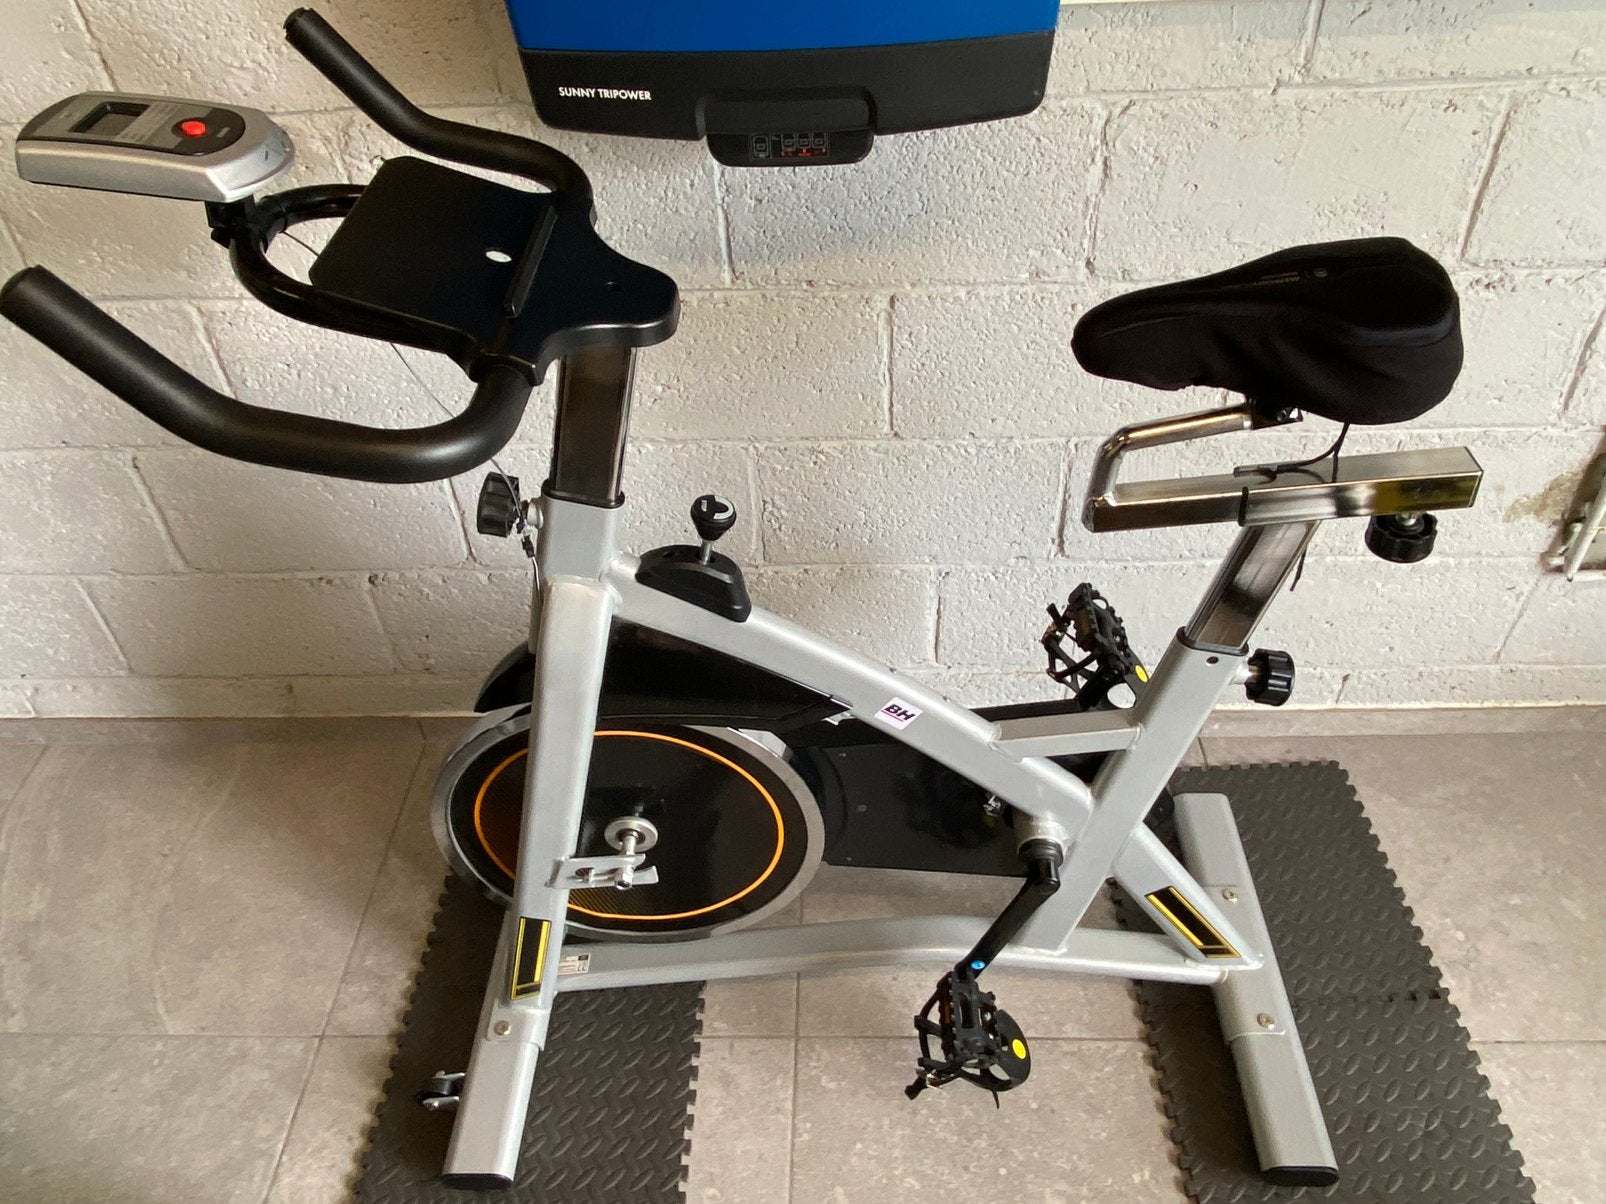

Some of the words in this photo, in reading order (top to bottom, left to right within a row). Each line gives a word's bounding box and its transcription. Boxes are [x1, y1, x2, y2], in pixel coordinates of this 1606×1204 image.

[558, 86, 596, 99] SUNNY
[597, 88, 652, 102] TRIPOWER
[884, 703, 916, 721] BH
